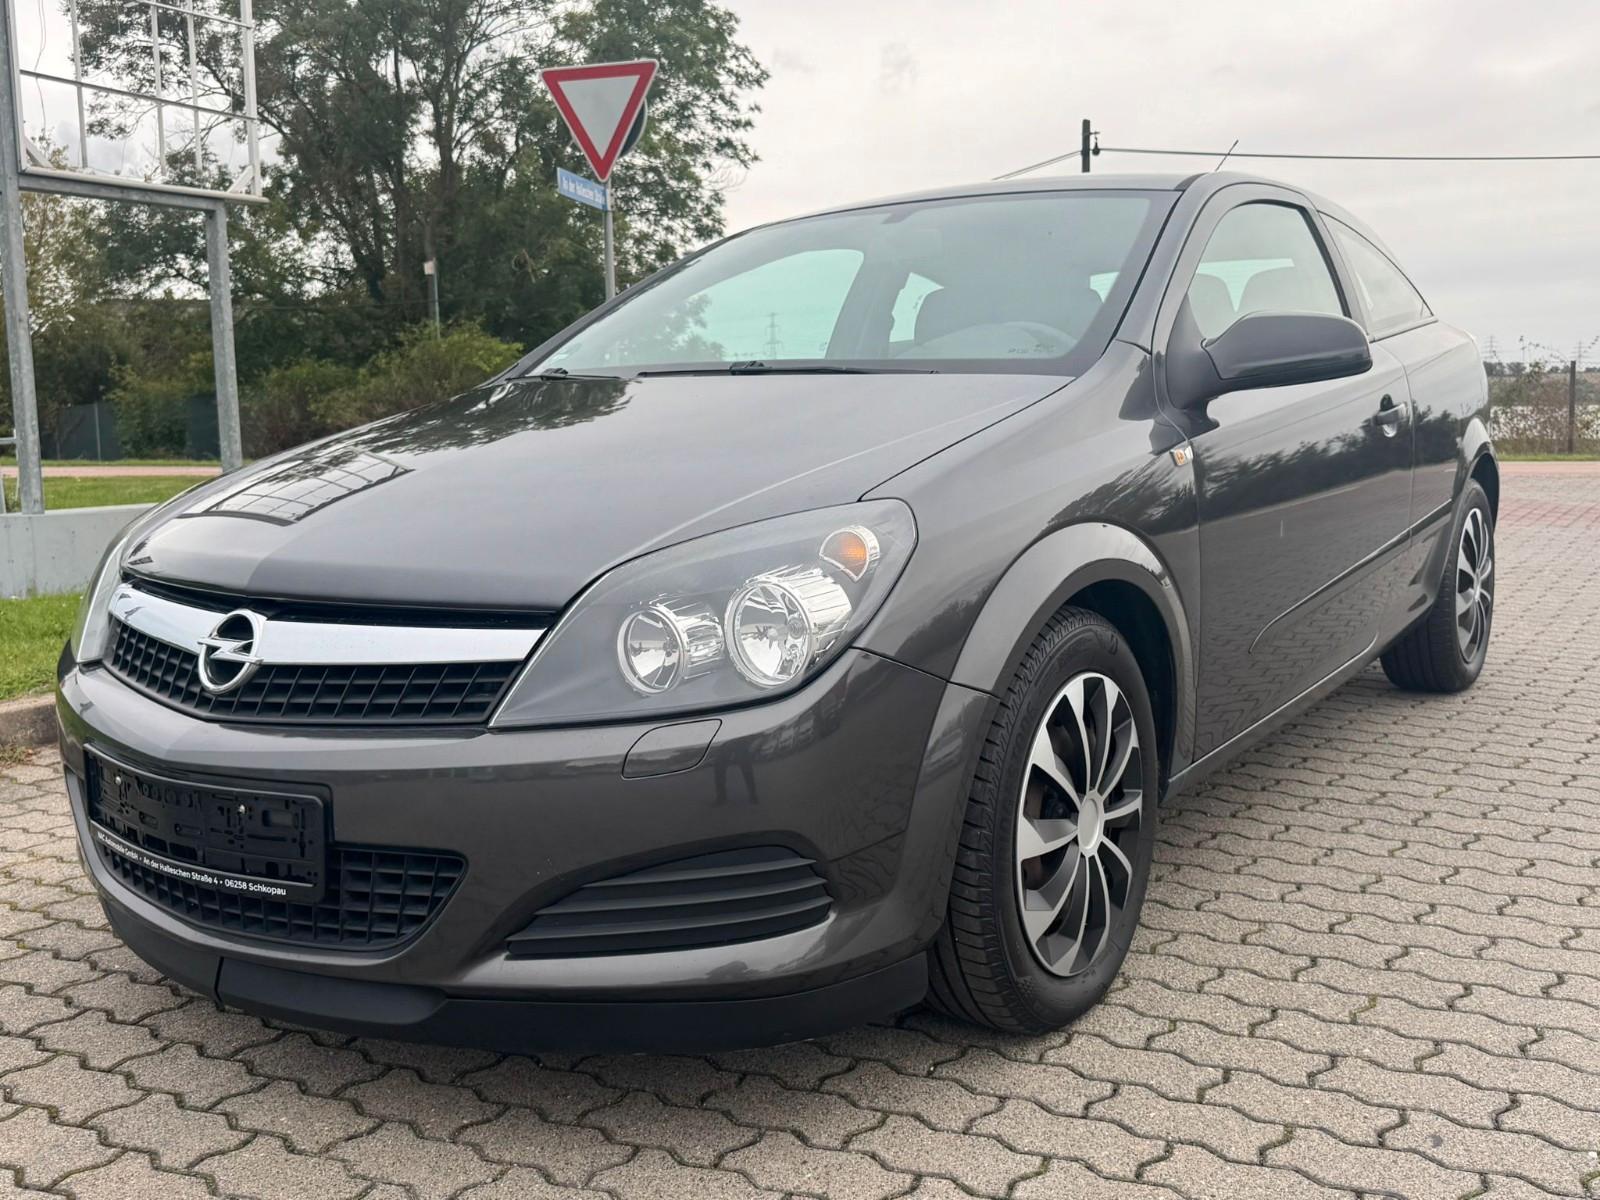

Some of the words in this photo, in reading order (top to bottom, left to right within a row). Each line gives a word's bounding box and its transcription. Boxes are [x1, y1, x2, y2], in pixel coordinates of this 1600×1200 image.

[159, 863, 191, 878] Halleschen
[191, 871, 213, 884] Straße
[224, 879, 247, 890] 06258
[248, 883, 287, 896] Schkopau
